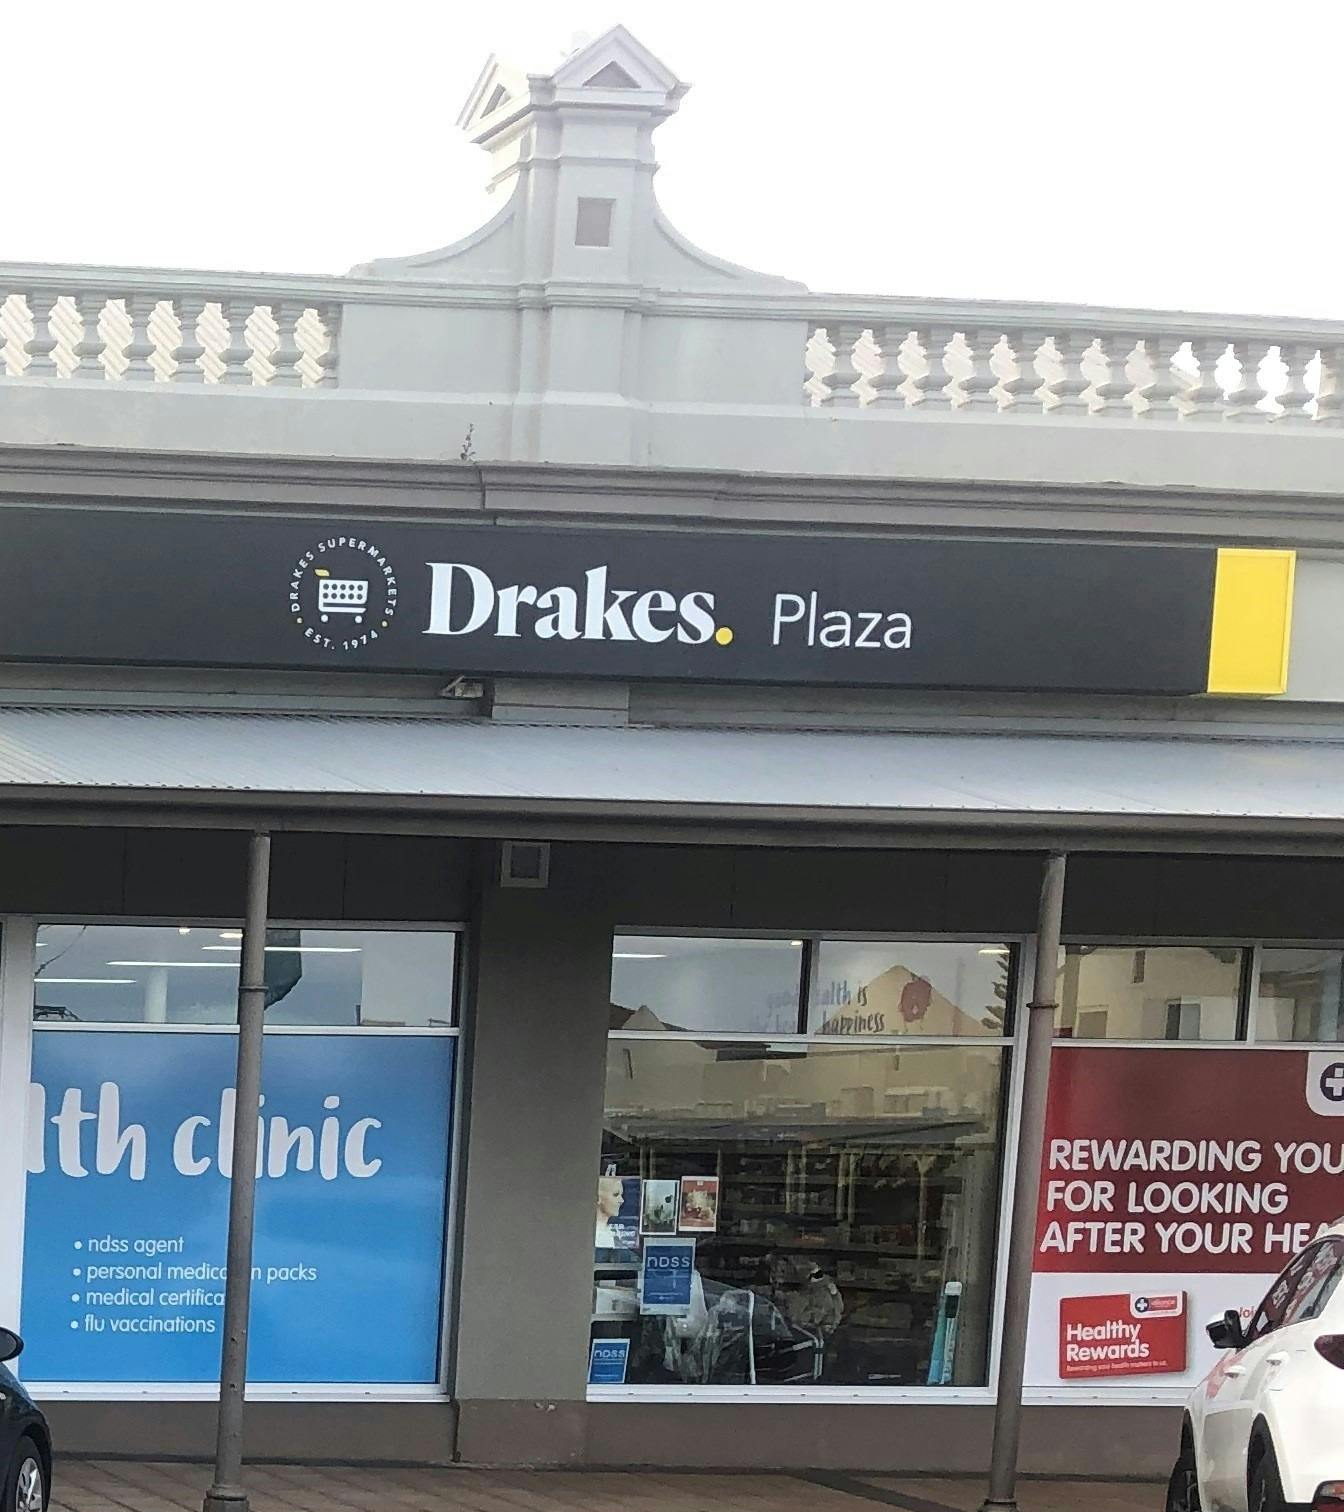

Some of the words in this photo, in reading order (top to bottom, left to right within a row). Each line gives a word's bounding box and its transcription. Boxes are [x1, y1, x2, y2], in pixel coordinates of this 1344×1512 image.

[290, 551, 314, 612] DRAKES
[318, 537, 397, 616] SUPERMARKETS
[771, 593, 912, 649] Plaza
[305, 628, 335, 650] EST.
[343, 630, 377, 650] 1974
[1049, 1139, 1261, 1172] REWARDING
[1274, 1142, 1344, 1174] YOU
[1046, 1180, 1114, 1213] FOR
[1128, 1182, 1289, 1215] LOOKING
[88, 1235, 128, 1253] ndss
[134, 1236, 184, 1256] agent
[1039, 1222, 1146, 1254] AFTER
[1154, 1222, 1253, 1254] YOUR
[87, 1262, 161, 1283] personal
[167, 1263, 262, 1280] medican
[267, 1263, 317, 1284] packs
[87, 1288, 154, 1306] medical
[159, 1289, 226, 1306] certifica
[85, 1314, 105, 1332] flu
[110, 1315, 215, 1332] vaccinations
[1066, 1320, 1141, 1342] Healthy
[1066, 1339, 1150, 1361] Rewards
